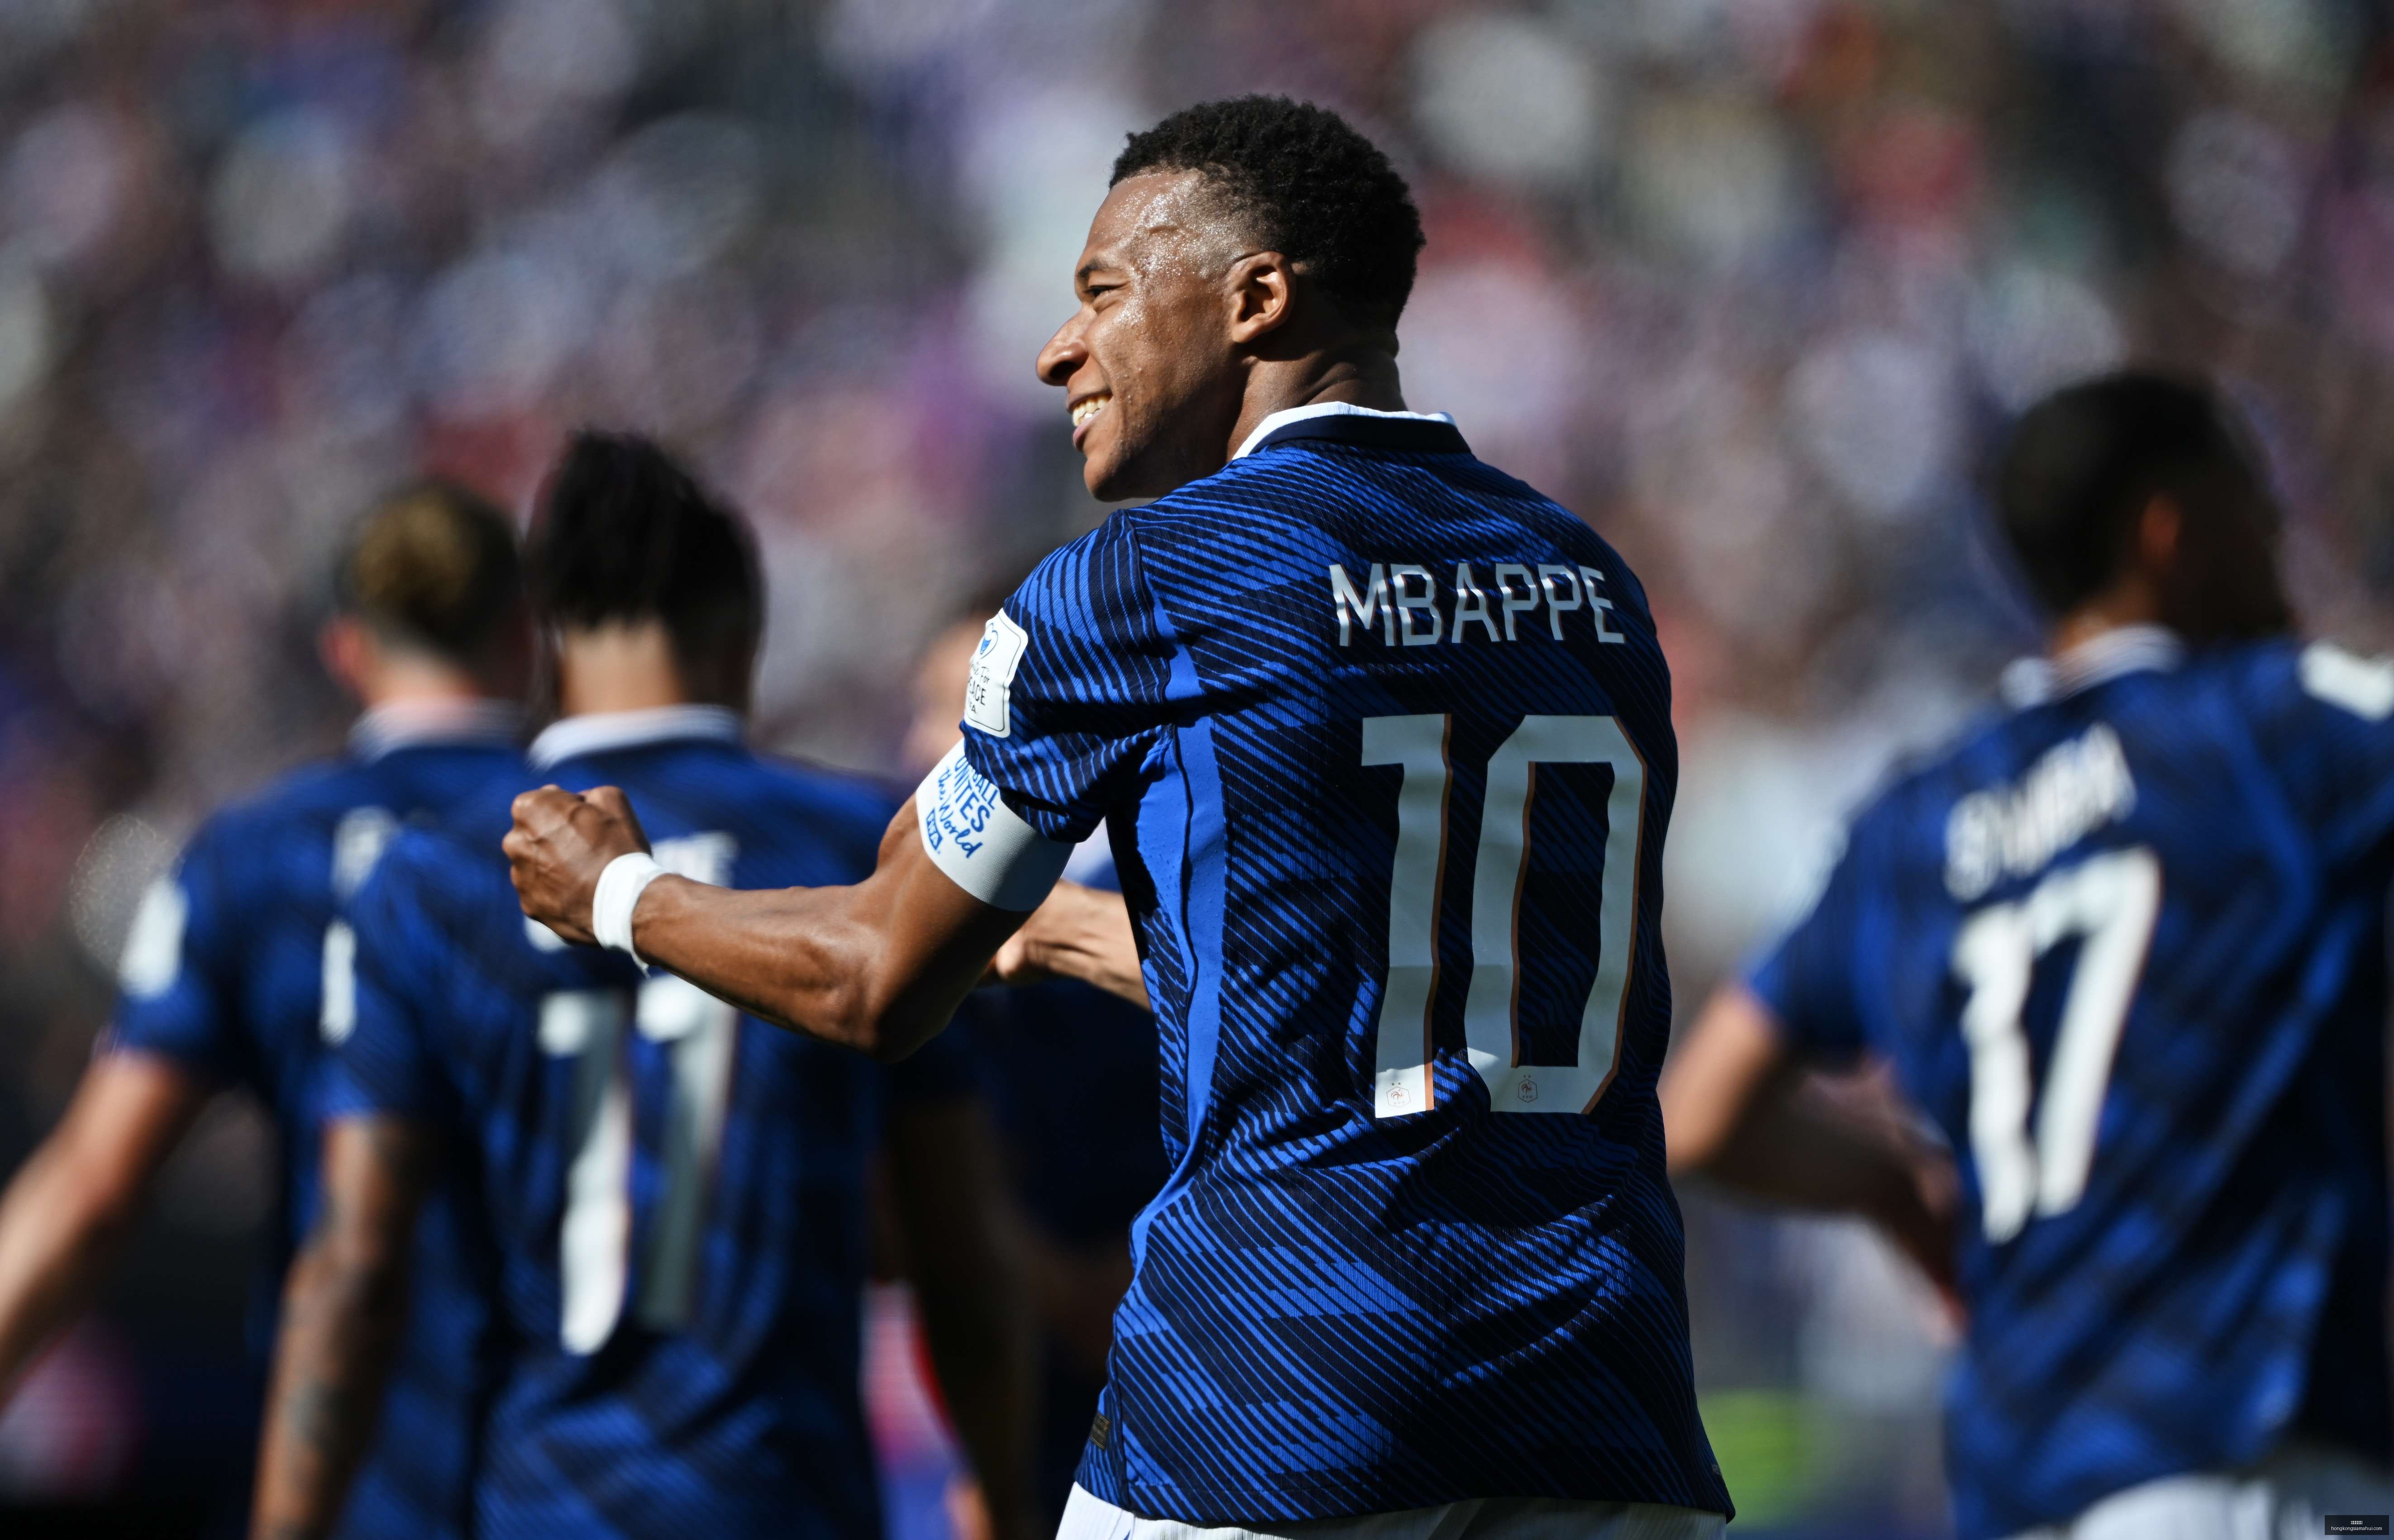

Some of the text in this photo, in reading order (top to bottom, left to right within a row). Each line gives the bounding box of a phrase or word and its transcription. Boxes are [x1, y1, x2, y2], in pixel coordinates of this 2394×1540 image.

[1329, 562, 1626, 647] MBAPPE
[939, 794, 983, 858] World
[1361, 713, 1648, 1118] 10
[1950, 845, 2161, 1244] 17
